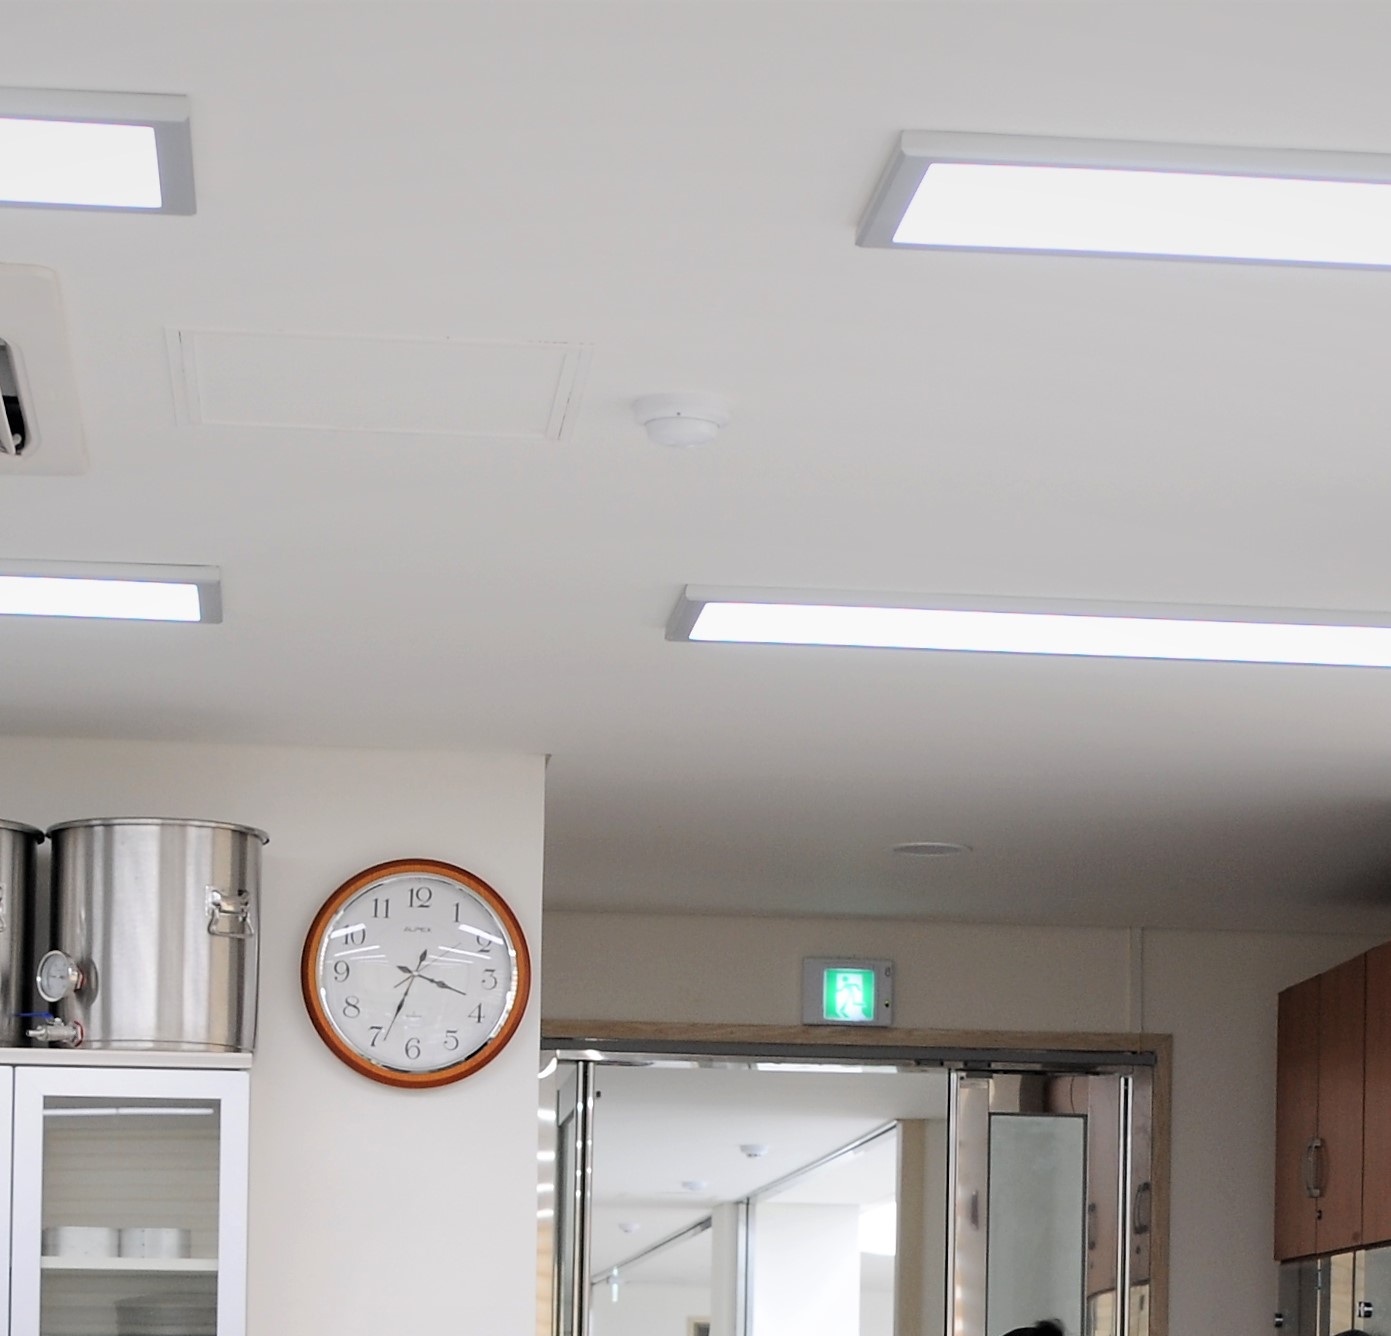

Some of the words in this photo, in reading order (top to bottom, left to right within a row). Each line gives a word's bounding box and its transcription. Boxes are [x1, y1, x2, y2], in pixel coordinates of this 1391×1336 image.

[371, 897, 391, 919] 11
[407, 886, 433, 908] 12
[451, 901, 461, 923] 1
[343, 924, 367, 946] 10
[476, 930, 493, 953] 2
[333, 960, 350, 982] 9
[481, 968, 498, 990] 3
[343, 995, 360, 1018] 8
[467, 1002, 486, 1024] 4
[369, 1025, 384, 1047] 7
[444, 1029, 460, 1051] 5
[405, 1037, 421, 1060] 6
